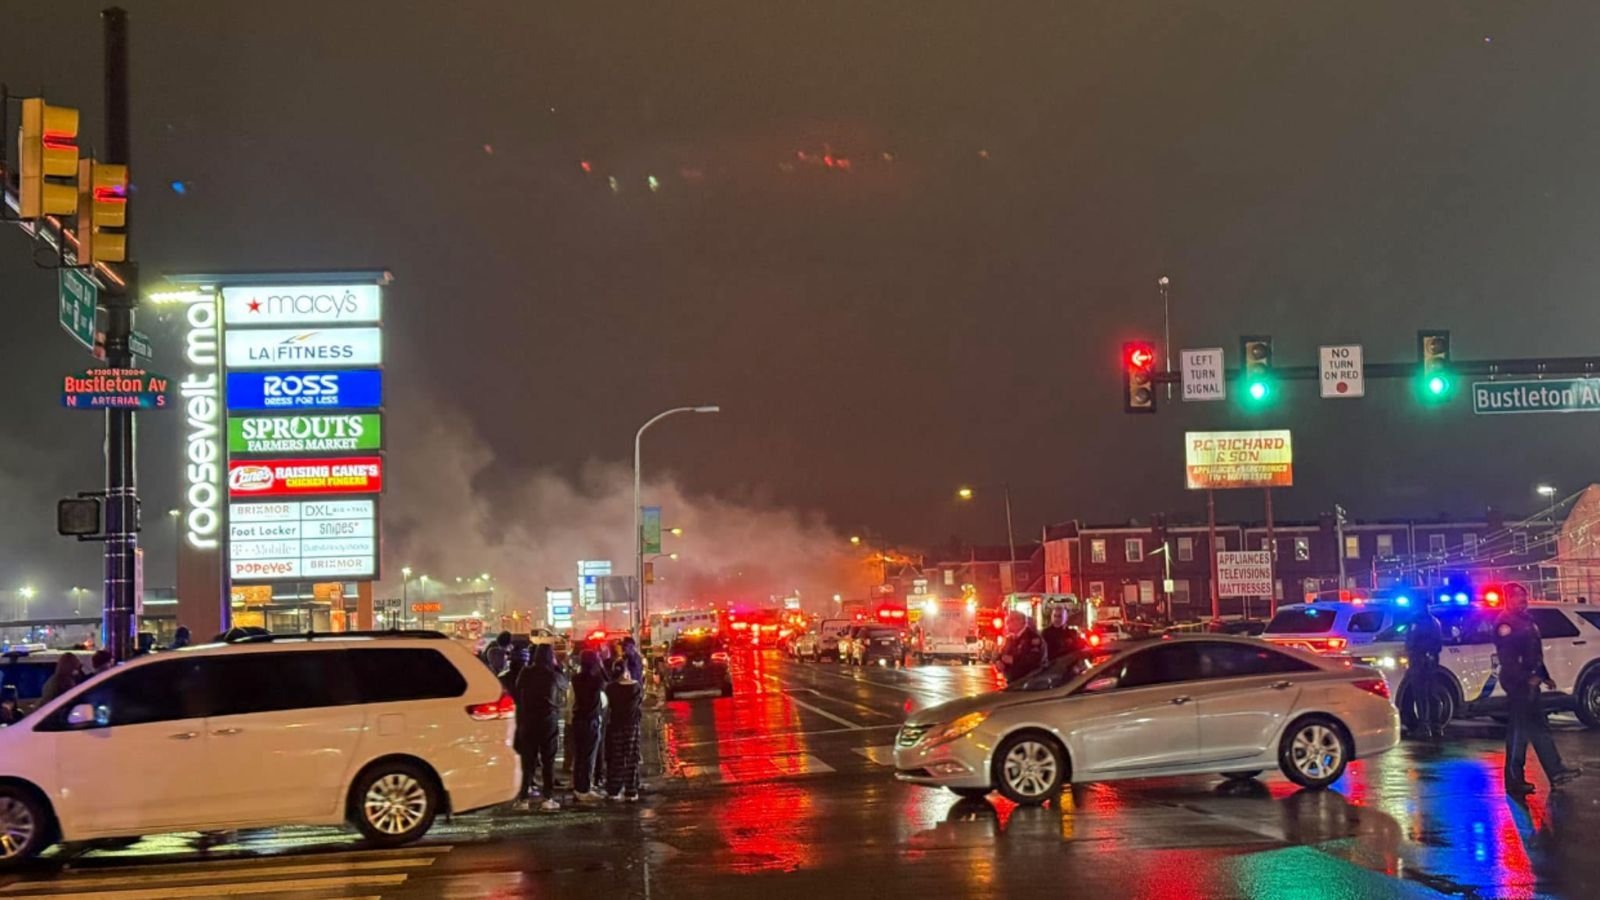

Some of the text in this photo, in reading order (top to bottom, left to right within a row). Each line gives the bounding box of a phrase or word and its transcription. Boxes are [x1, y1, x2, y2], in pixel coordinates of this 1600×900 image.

[267, 289, 358, 318] macy's
[1331, 348, 1349, 358] NO
[1190, 355, 1213, 365] LEFT
[1329, 361, 1353, 369] TURN
[1191, 370, 1215, 379] TURN
[1324, 371, 1358, 380] ON RED
[64, 376, 167, 392] Bustleton Av
[264, 374, 339, 396] ROSS
[1187, 384, 1220, 394] SIGNAL
[66, 394, 165, 406] N ARTERIAL S
[264, 396, 338, 405] DRESS FOR LESS
[1477, 386, 1573, 408] Bustleton
[242, 415, 364, 439] SPROUTS
[247, 438, 358, 452] FARMERS MARKET
[1217, 438, 1285, 450] RICHARD
[181, 373, 218, 549] roosevelt
[1217, 451, 1260, 462] & SON
[275, 464, 378, 479] RAISING CANE'S
[305, 505, 333, 517] DXL
[231, 525, 297, 537] Foot Locker
[1219, 553, 1270, 565] APPLIANCES
[1219, 568, 1271, 580] TELEVISIONS
[1219, 582, 1271, 594] MATTRESSES
